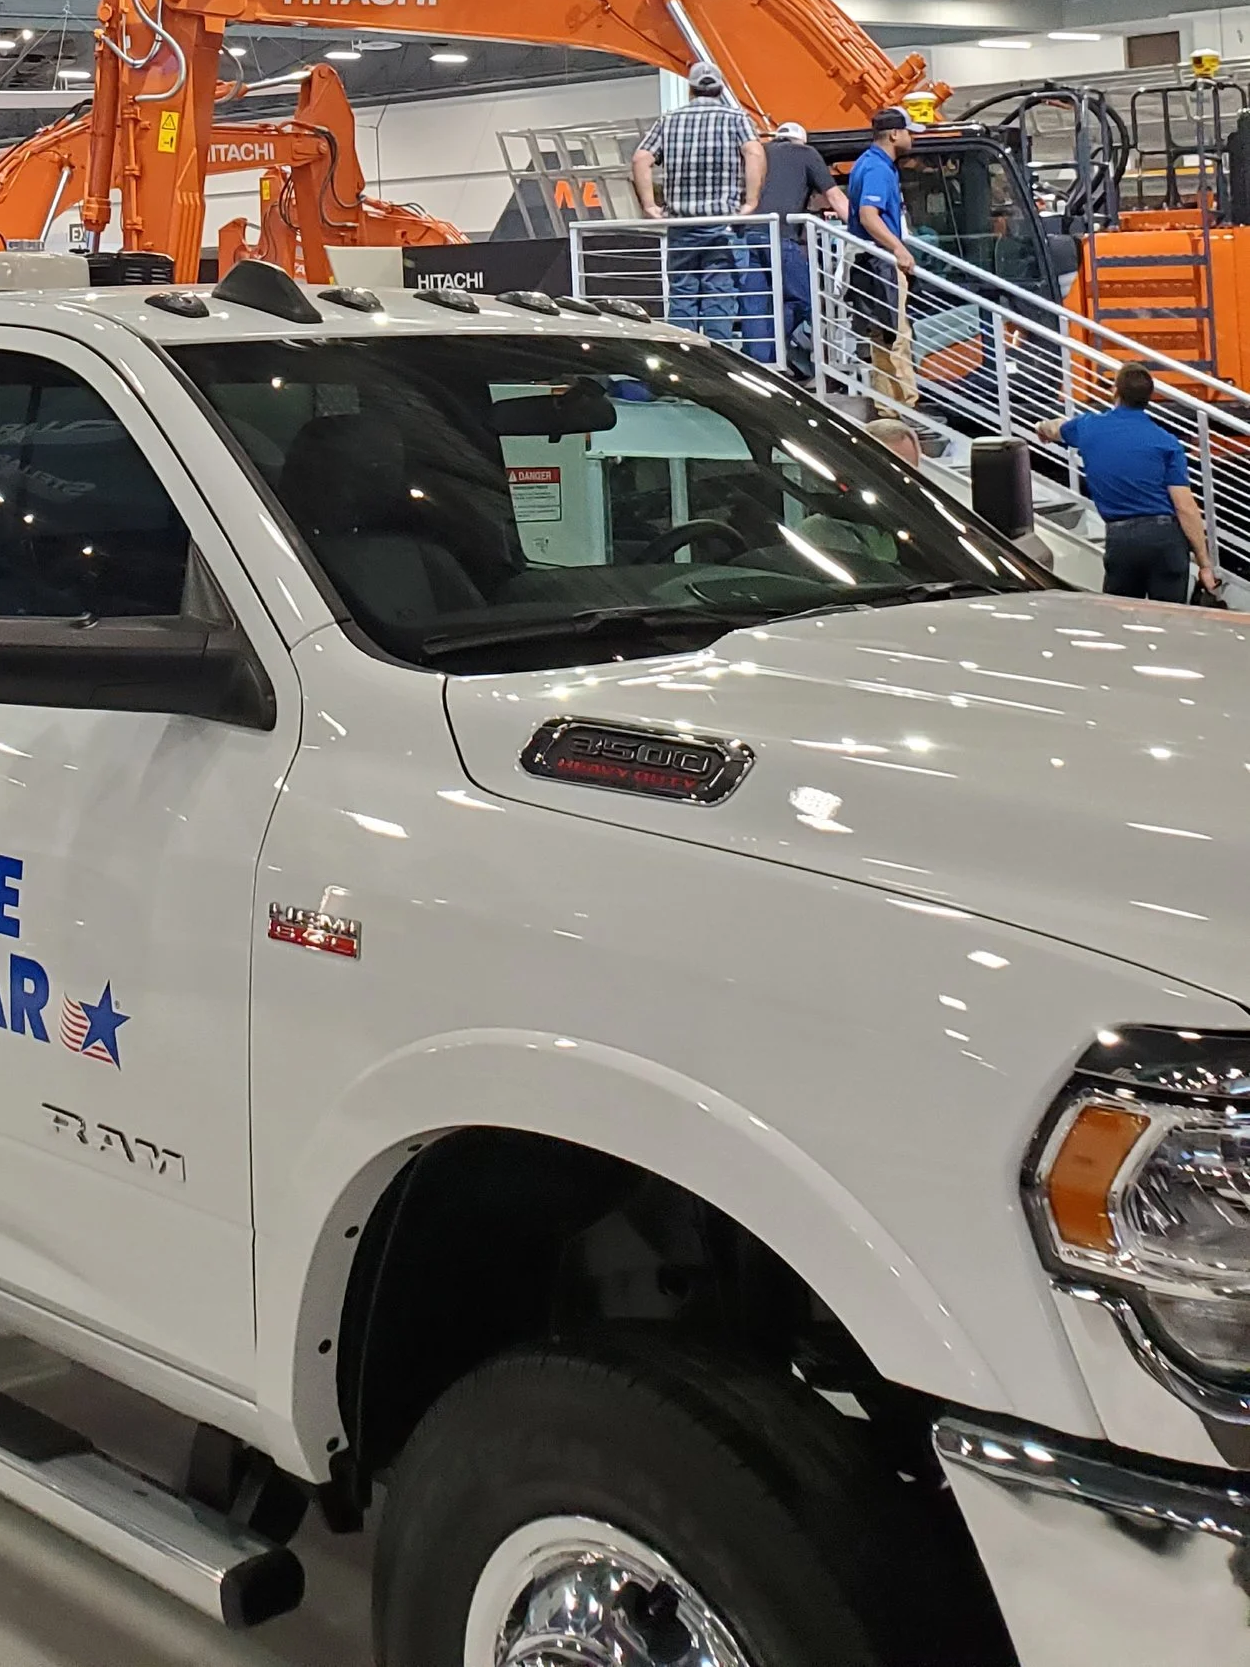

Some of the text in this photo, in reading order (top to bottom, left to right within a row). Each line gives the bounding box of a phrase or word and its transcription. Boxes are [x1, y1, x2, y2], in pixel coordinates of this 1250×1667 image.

[208, 142, 275, 162] ITACHI
[417, 272, 484, 290] HITACHI
[518, 471, 552, 481] DANGER
[569, 736, 713, 774] 3500
[41, 1102, 186, 1182] RAM
